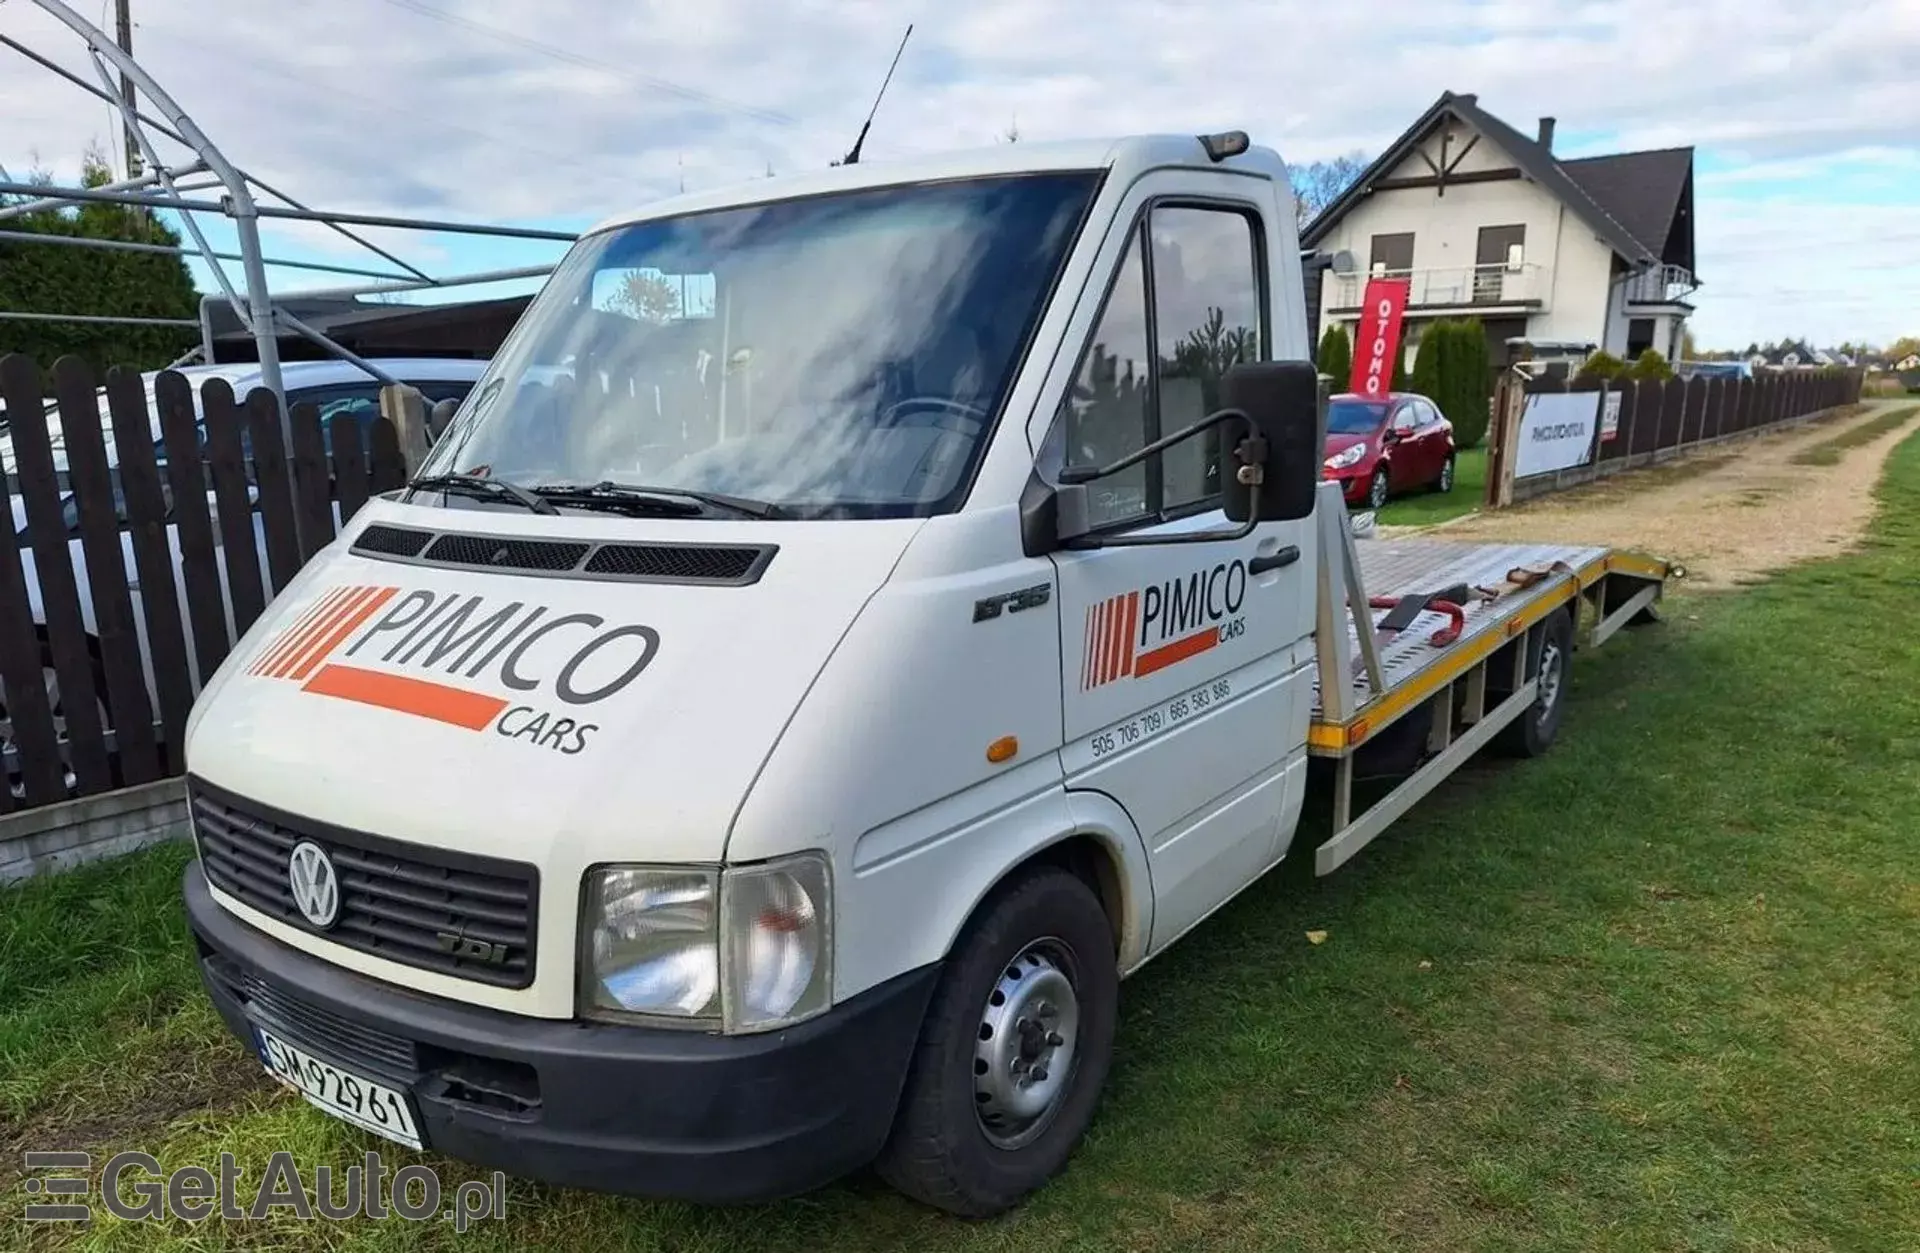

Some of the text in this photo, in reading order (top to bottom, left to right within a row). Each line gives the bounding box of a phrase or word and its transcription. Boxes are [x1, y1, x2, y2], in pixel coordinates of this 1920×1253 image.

[1141, 559, 1246, 647] PIMICO
[1219, 616, 1246, 643] CARS
[345, 589, 661, 705] PIMICO
[496, 706, 599, 755] CARS
[1091, 732, 1116, 757] 505
[1117, 722, 1140, 745] 706
[1169, 698, 1190, 721] 665
[1191, 689, 1211, 711] 583
[437, 931, 508, 963] TDI
